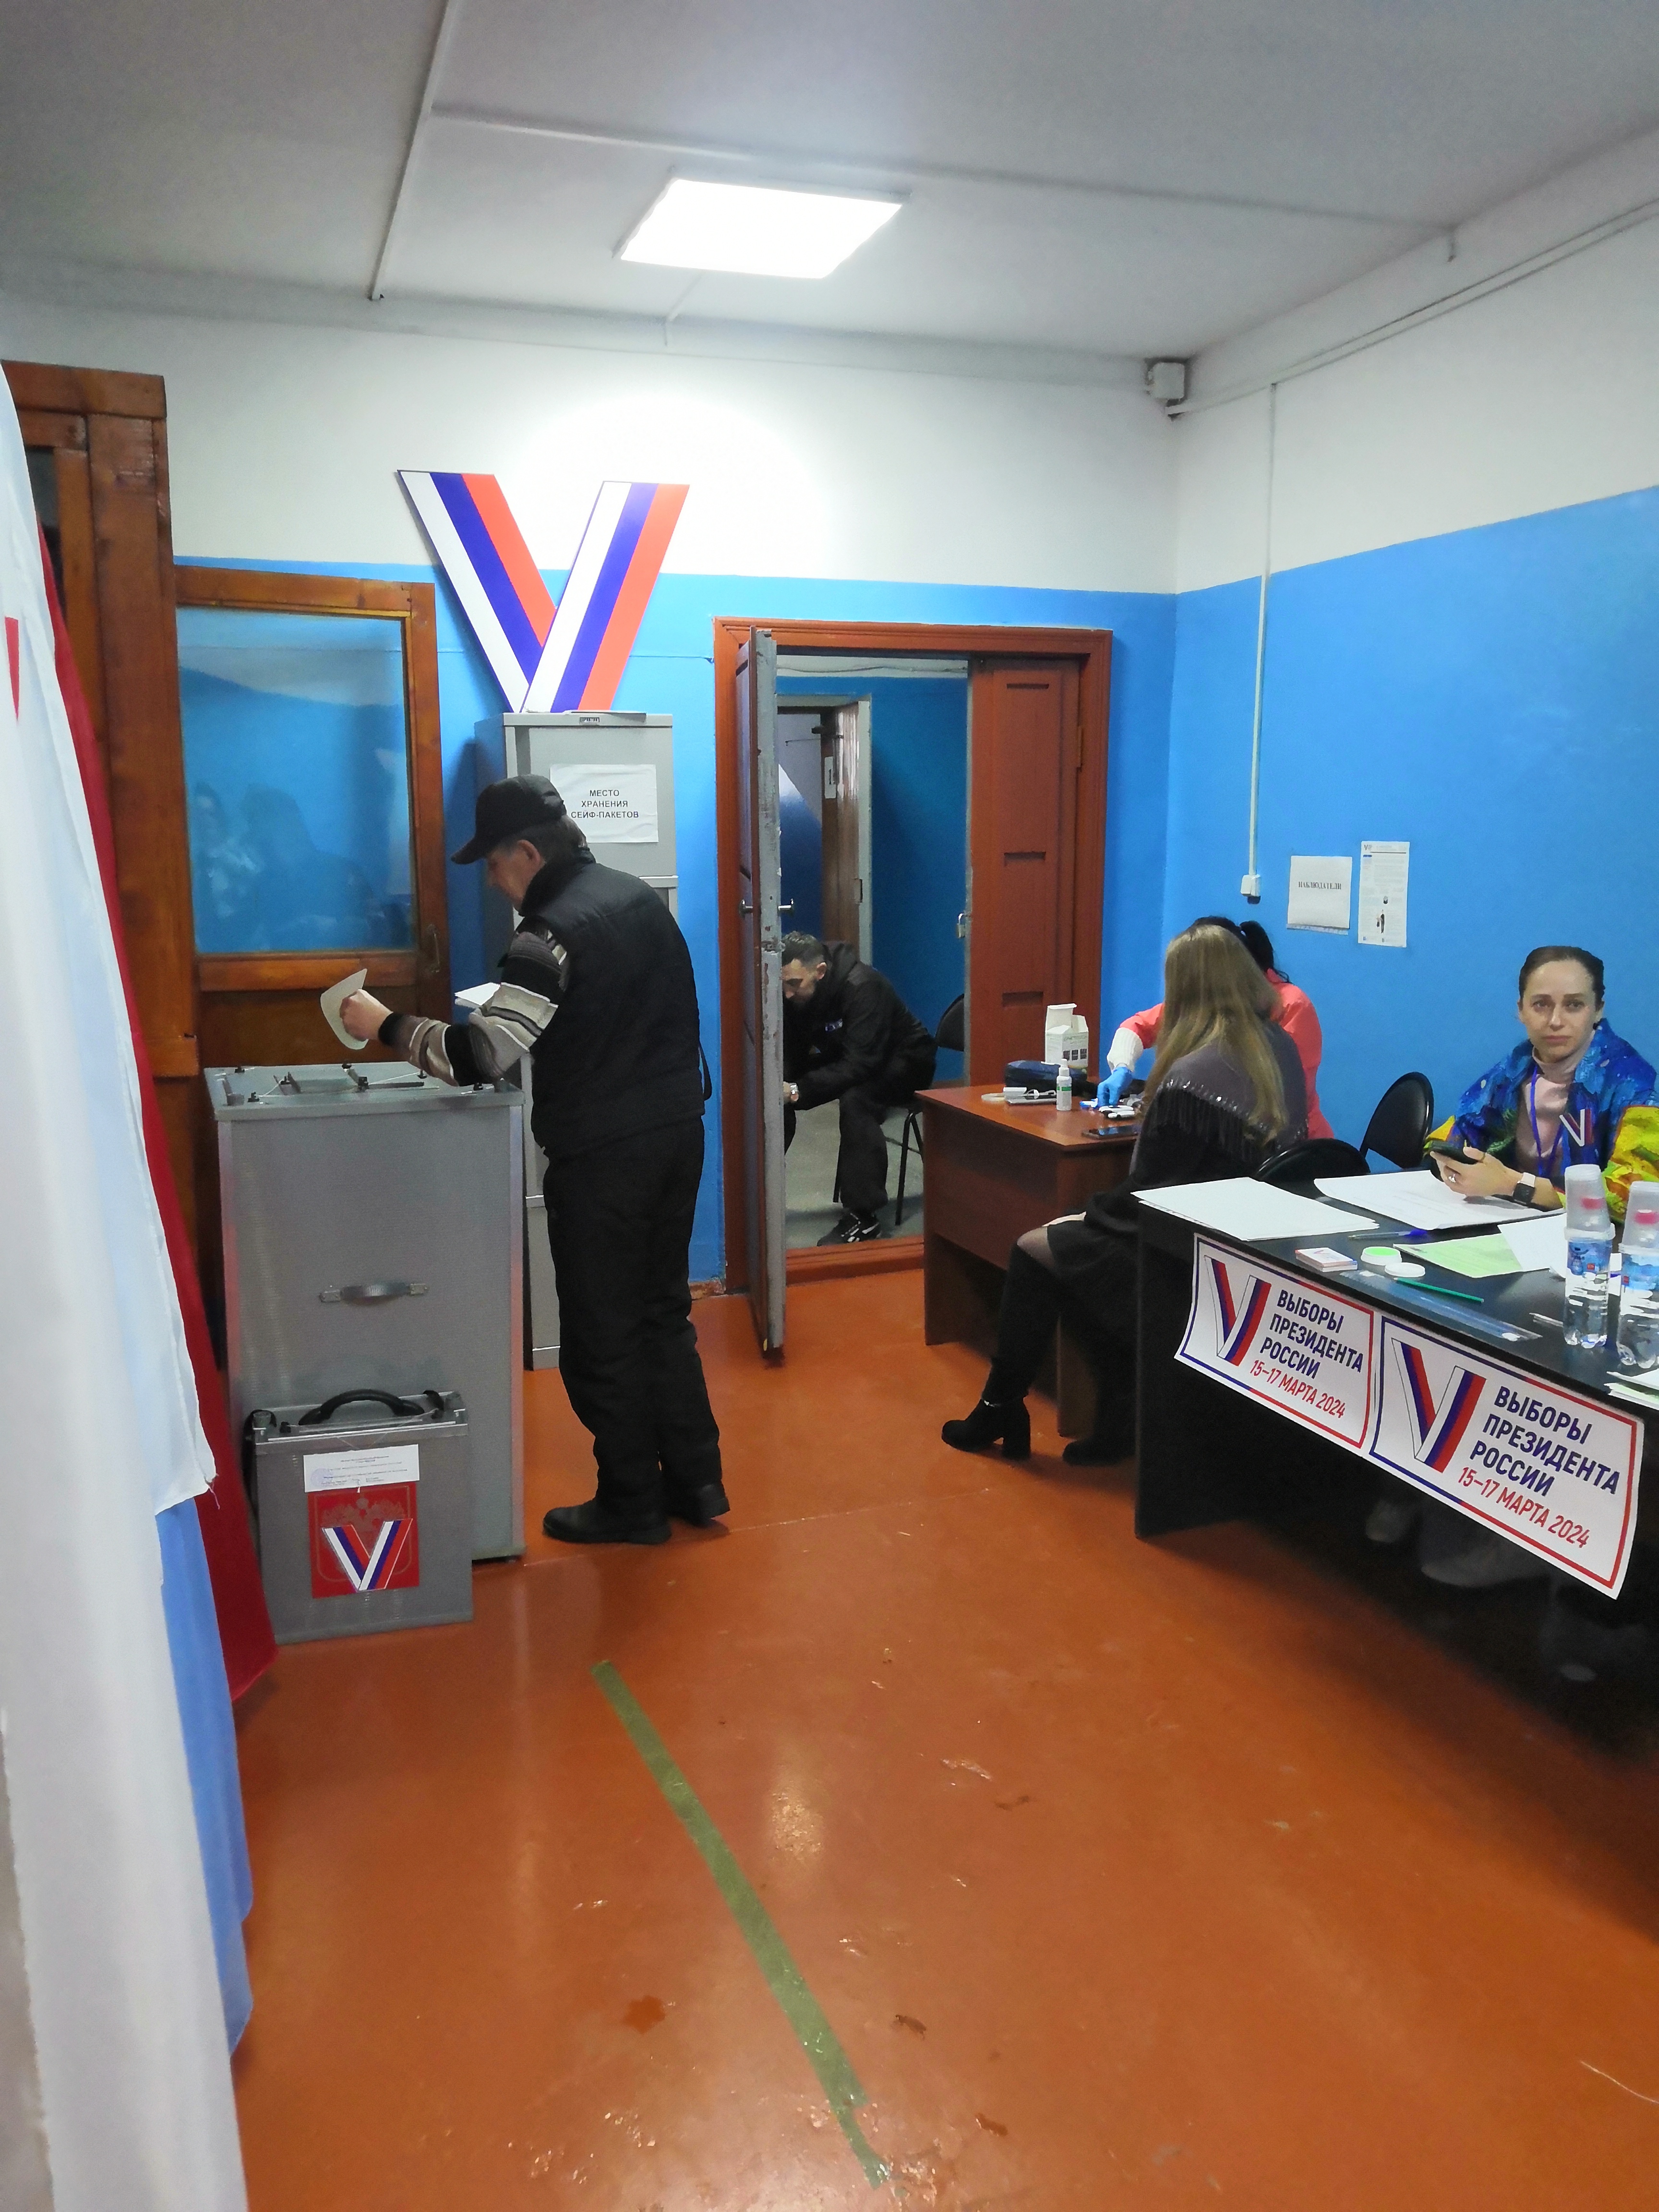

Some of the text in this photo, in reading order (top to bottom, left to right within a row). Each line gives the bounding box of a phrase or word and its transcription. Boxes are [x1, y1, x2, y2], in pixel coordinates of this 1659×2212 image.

[1298, 881, 1342, 890] НАБЛЮДАТЕЛИ
[1277, 1289, 1344, 1334] ВЫБОРЫ
[1260, 1337, 1321, 1379] РОССИИ
[1270, 1313, 1364, 1373] ПРЕЗИДЕНТА
[1278, 1373, 1318, 1405] МАРТА
[1315, 1392, 1346, 1419] 2024
[1494, 1386, 1593, 1444] ВЫБОРЫ
[1470, 1441, 1555, 1497] РОССИИ
[1482, 1413, 1620, 1494] ПРЕЗИДЕНТА
[1496, 1487, 1550, 1527] МАРТА
[1548, 1515, 1590, 1549] 2024
